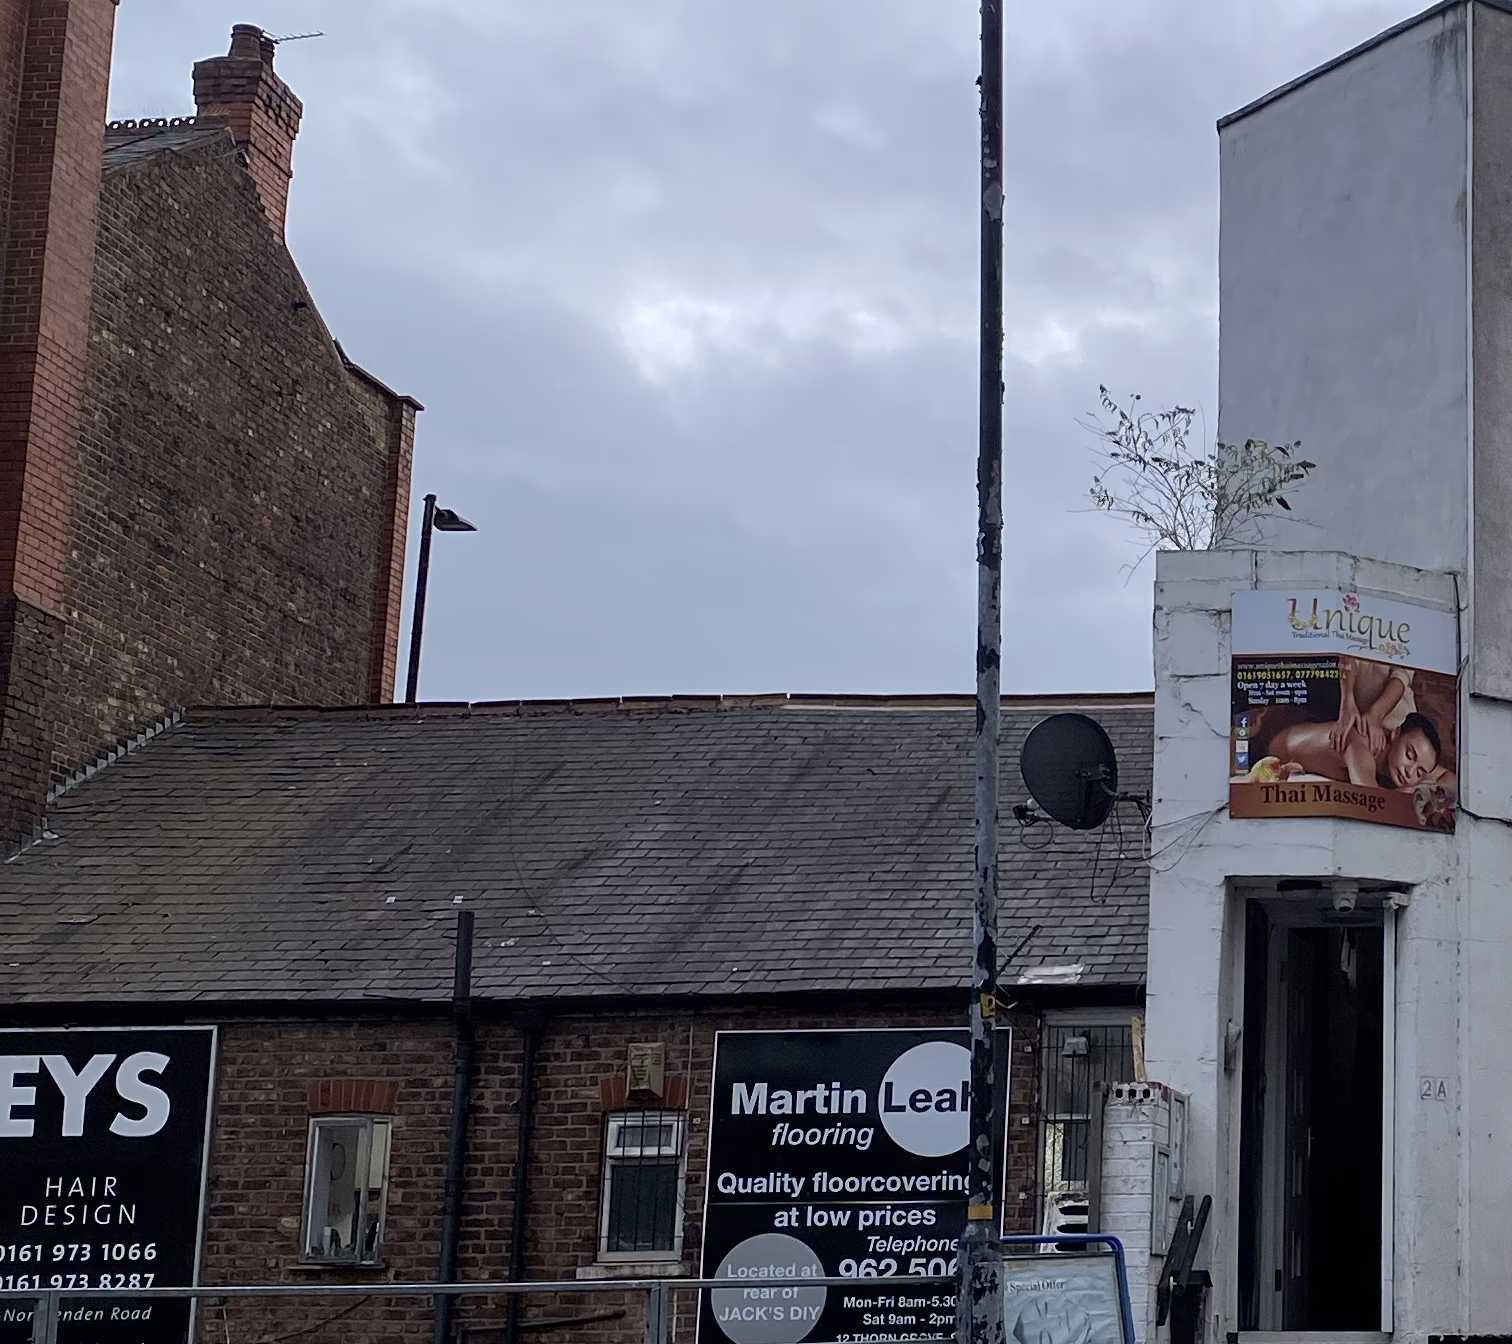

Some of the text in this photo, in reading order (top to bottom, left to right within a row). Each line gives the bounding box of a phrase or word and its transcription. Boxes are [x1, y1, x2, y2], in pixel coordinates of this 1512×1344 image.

[1287, 598, 1410, 650] Unique
[1237, 681, 1258, 691] Open
[1265, 680, 1279, 690] day
[1287, 680, 1307, 688] week
[1260, 784, 1386, 813] Thai Massage
[731, 1082, 867, 1115] Martin
[771, 1123, 874, 1151] flooring
[45, 1176, 117, 1197] HAIR
[717, 1172, 805, 1197] Quality
[21, 1204, 136, 1226] DESIGN
[774, 1205, 937, 1231] at low prices
[52, 1244, 91, 1262] 973
[101, 1243, 157, 1261] 1066
[867, 1236, 959, 1255] Telephone
[727, 1263, 817, 1278] Located at
[838, 1258, 898, 1278] 962
[0, 1273, 155, 1289] 161 973 8287
[1009, 1279, 1065, 1293] Special Offer
[743, 1286, 799, 1299] rear of
[843, 1296, 895, 1308] Mon-Fri
[3, 1306, 152, 1322] Nornden Road
[719, 1306, 820, 1321] JACK'S DIY
[863, 1313, 885, 1325] Sat
[888, 1313, 916, 1325] 9am
[836, 1334, 850, 1344] 12
[853, 1332, 896, 1343] THORN
